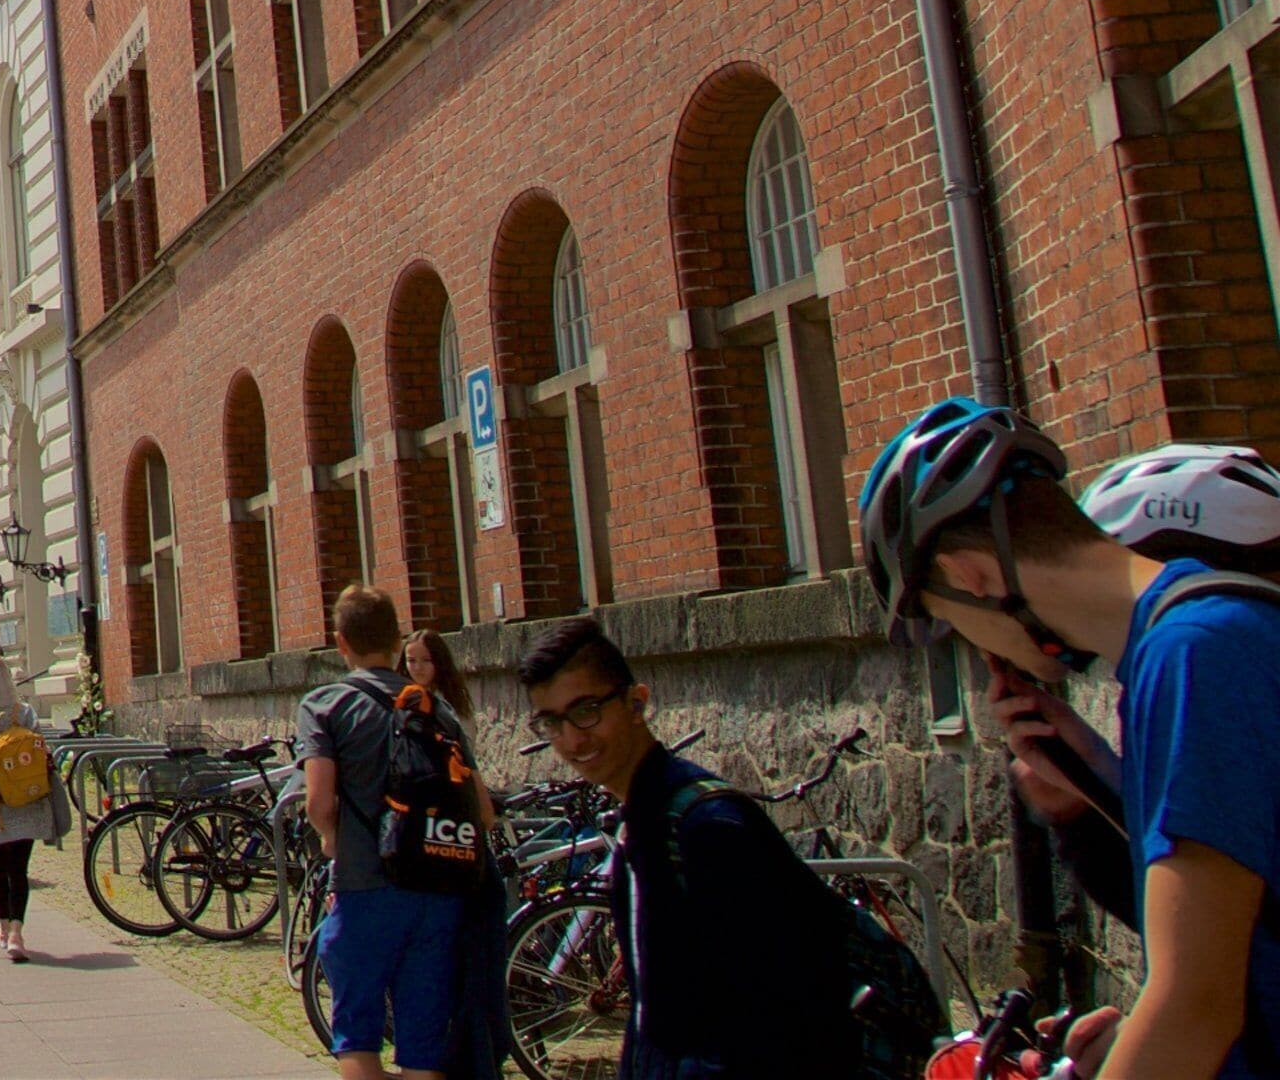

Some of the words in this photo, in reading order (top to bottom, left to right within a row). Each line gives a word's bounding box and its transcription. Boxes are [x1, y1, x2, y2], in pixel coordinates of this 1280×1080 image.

[472, 379, 487, 439] P
[1144, 492, 1201, 528] city
[425, 807, 476, 845] ice
[424, 844, 476, 861] watch
